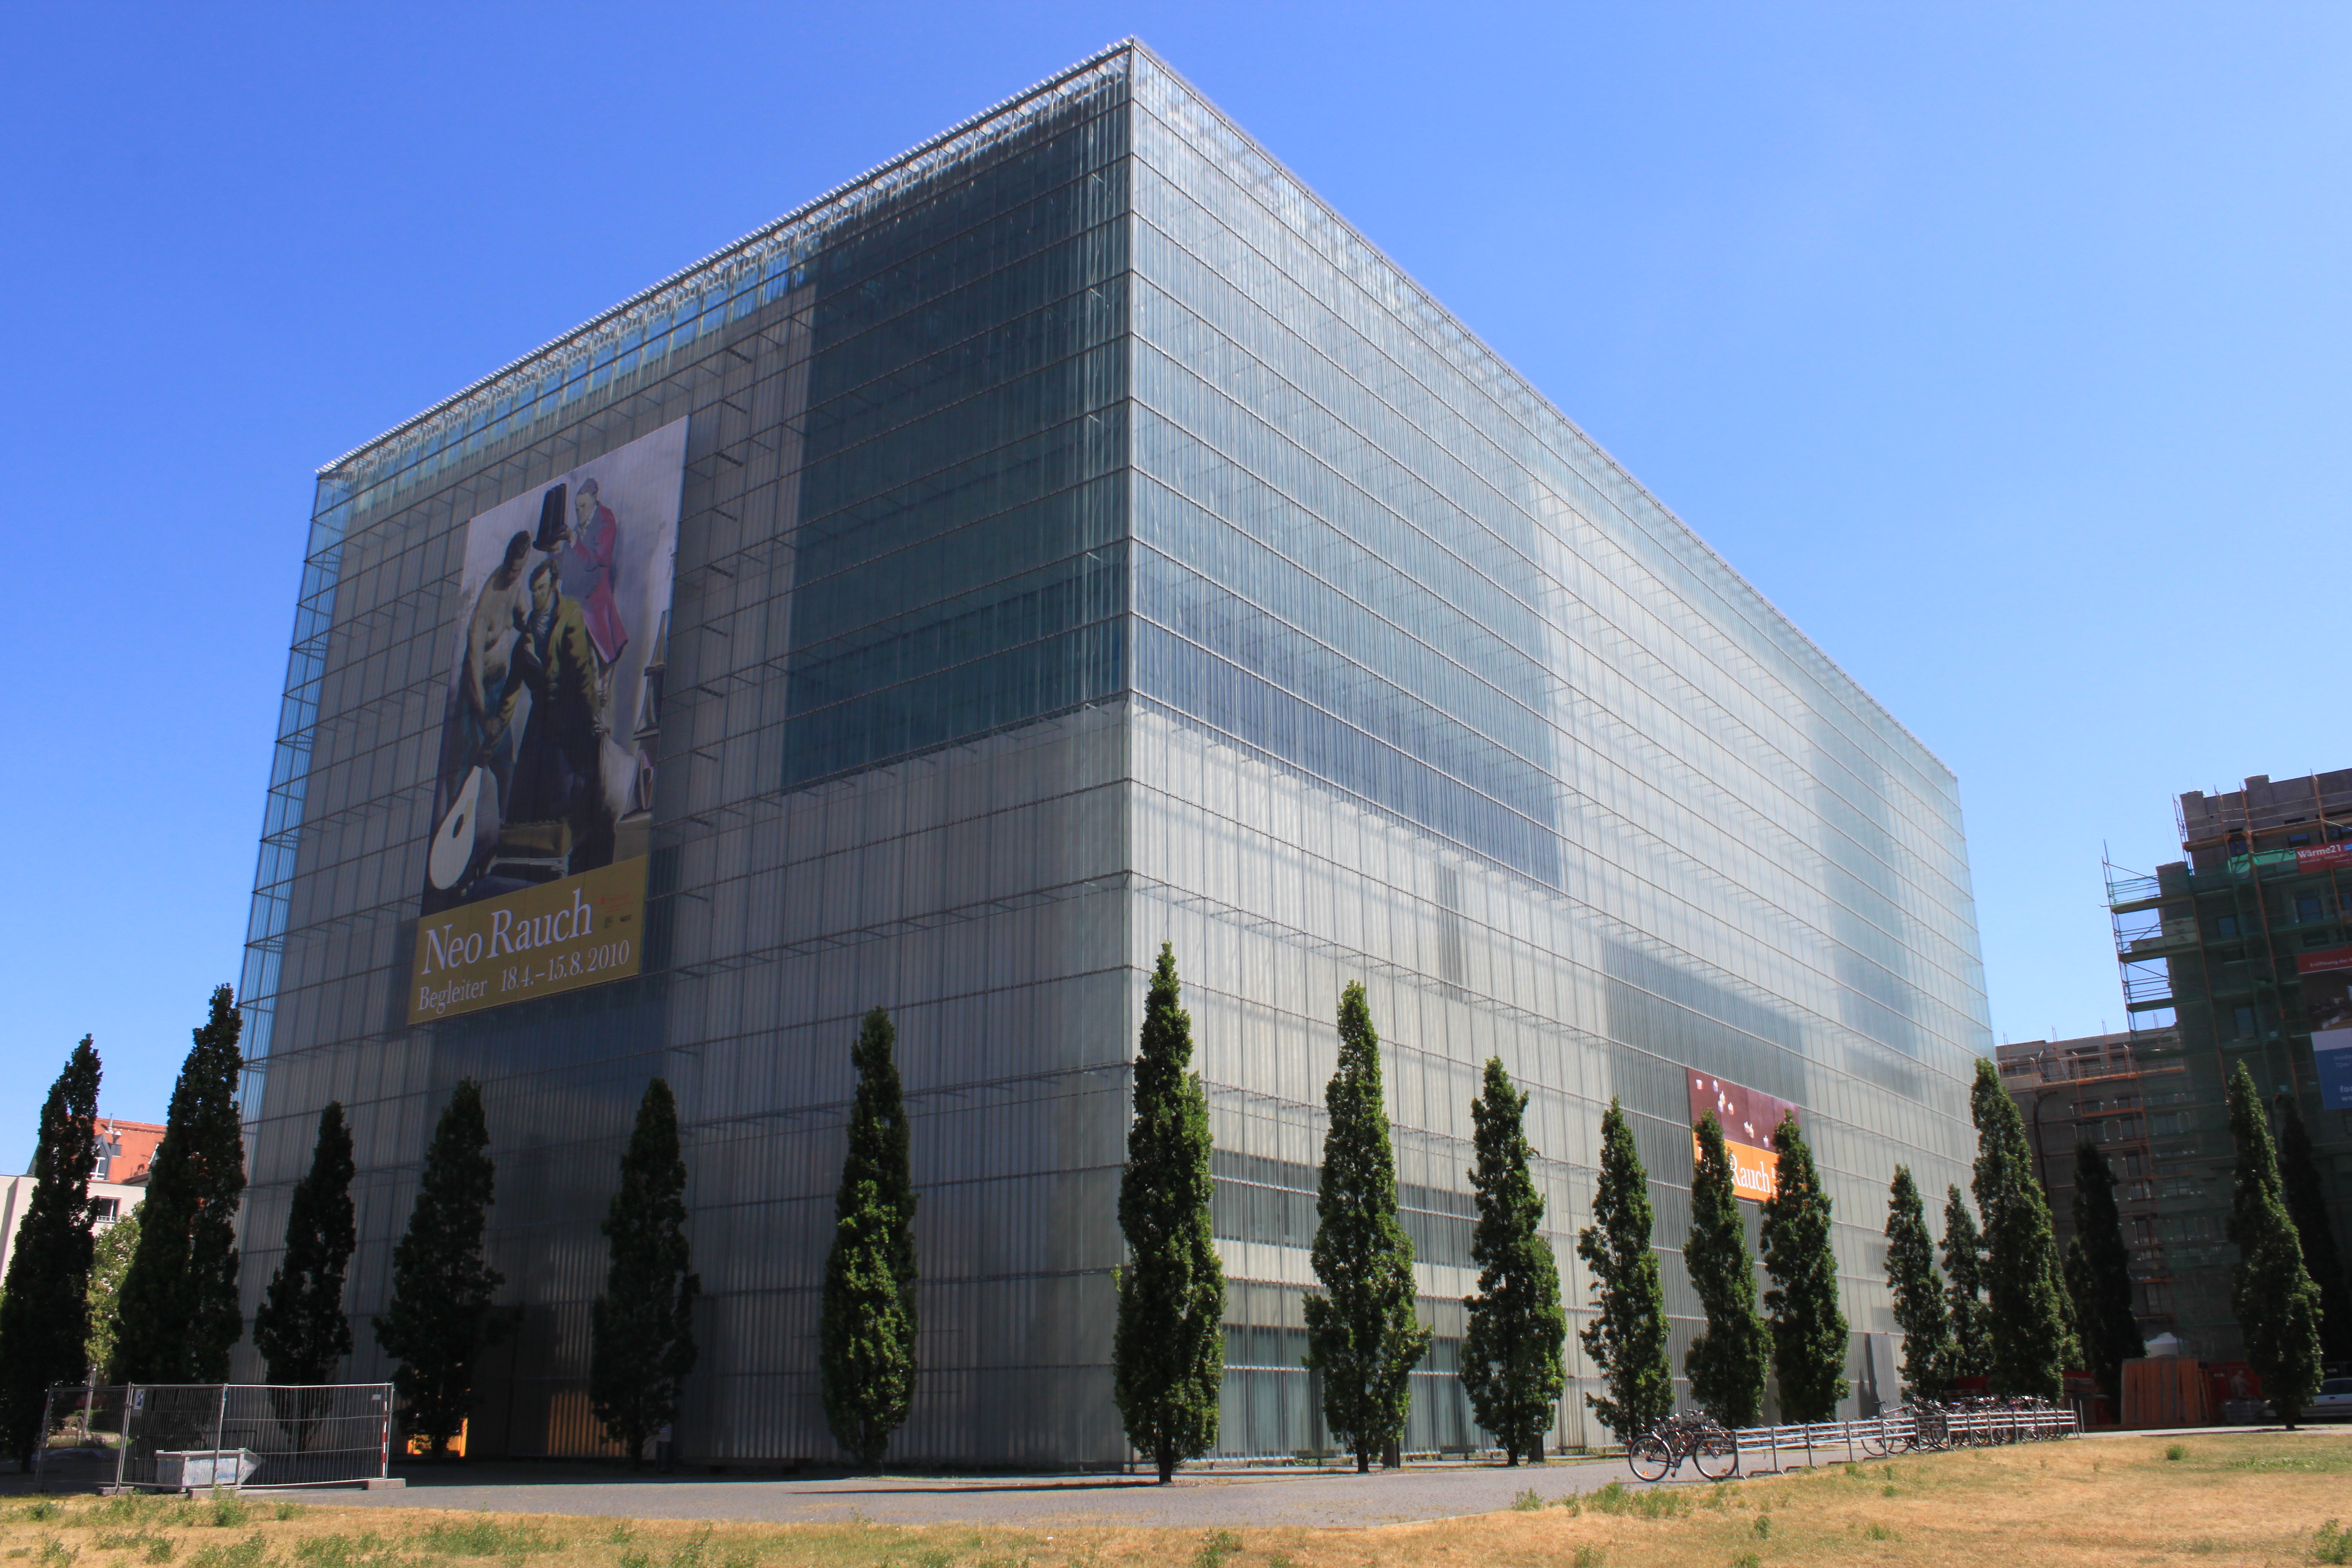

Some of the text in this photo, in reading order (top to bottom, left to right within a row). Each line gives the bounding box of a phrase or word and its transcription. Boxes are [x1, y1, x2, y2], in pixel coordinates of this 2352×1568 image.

[421, 887, 592, 975] Neo Rauch
[418, 979, 488, 1014] Begleiter
[1729, 1153, 1771, 1193] Rauch
